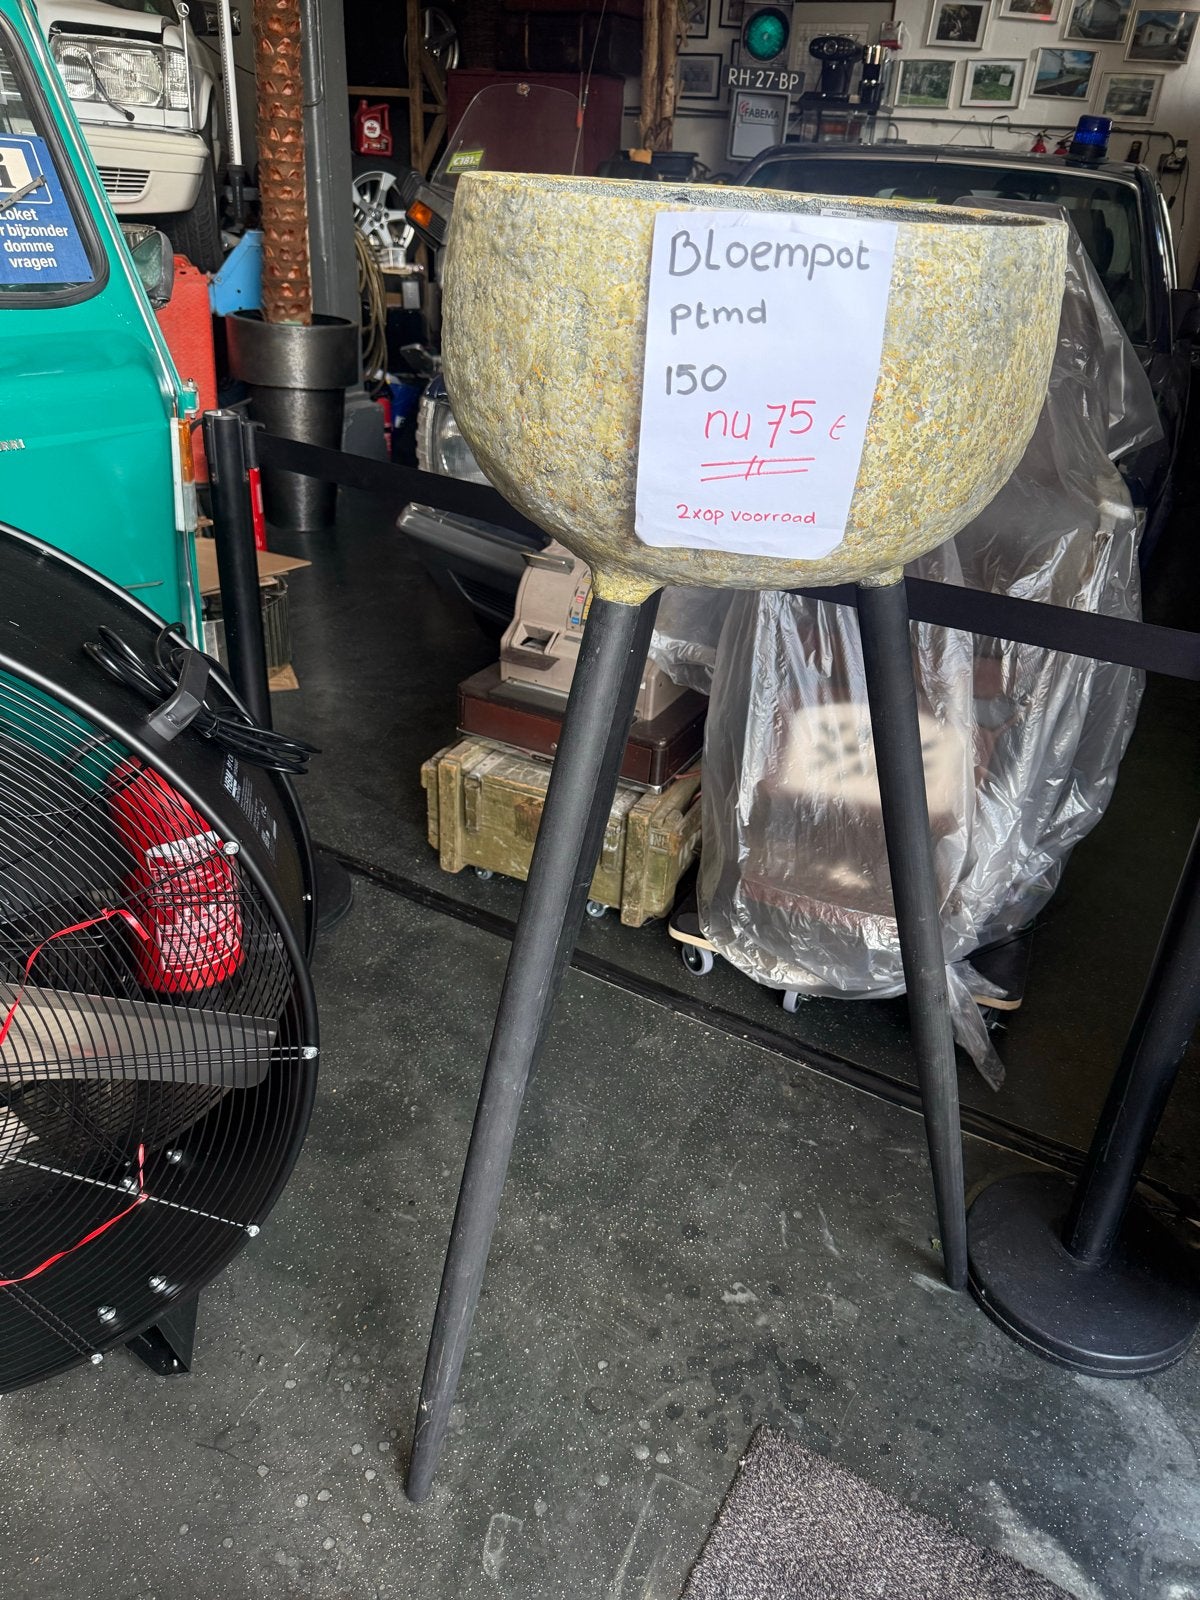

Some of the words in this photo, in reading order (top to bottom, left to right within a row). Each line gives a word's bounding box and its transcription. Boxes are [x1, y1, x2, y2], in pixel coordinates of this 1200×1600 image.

[728, 68, 799, 90] RH-27-BP
[744, 107, 779, 119] FABEMA
[6, 223, 68, 239] bijzonder
[4, 239, 54, 252] domme
[669, 228, 870, 280] Bloempot
[8, 257, 57, 270] vragen
[666, 364, 727, 395] 150
[704, 410, 751, 440] nu
[767, 400, 816, 448] 75
